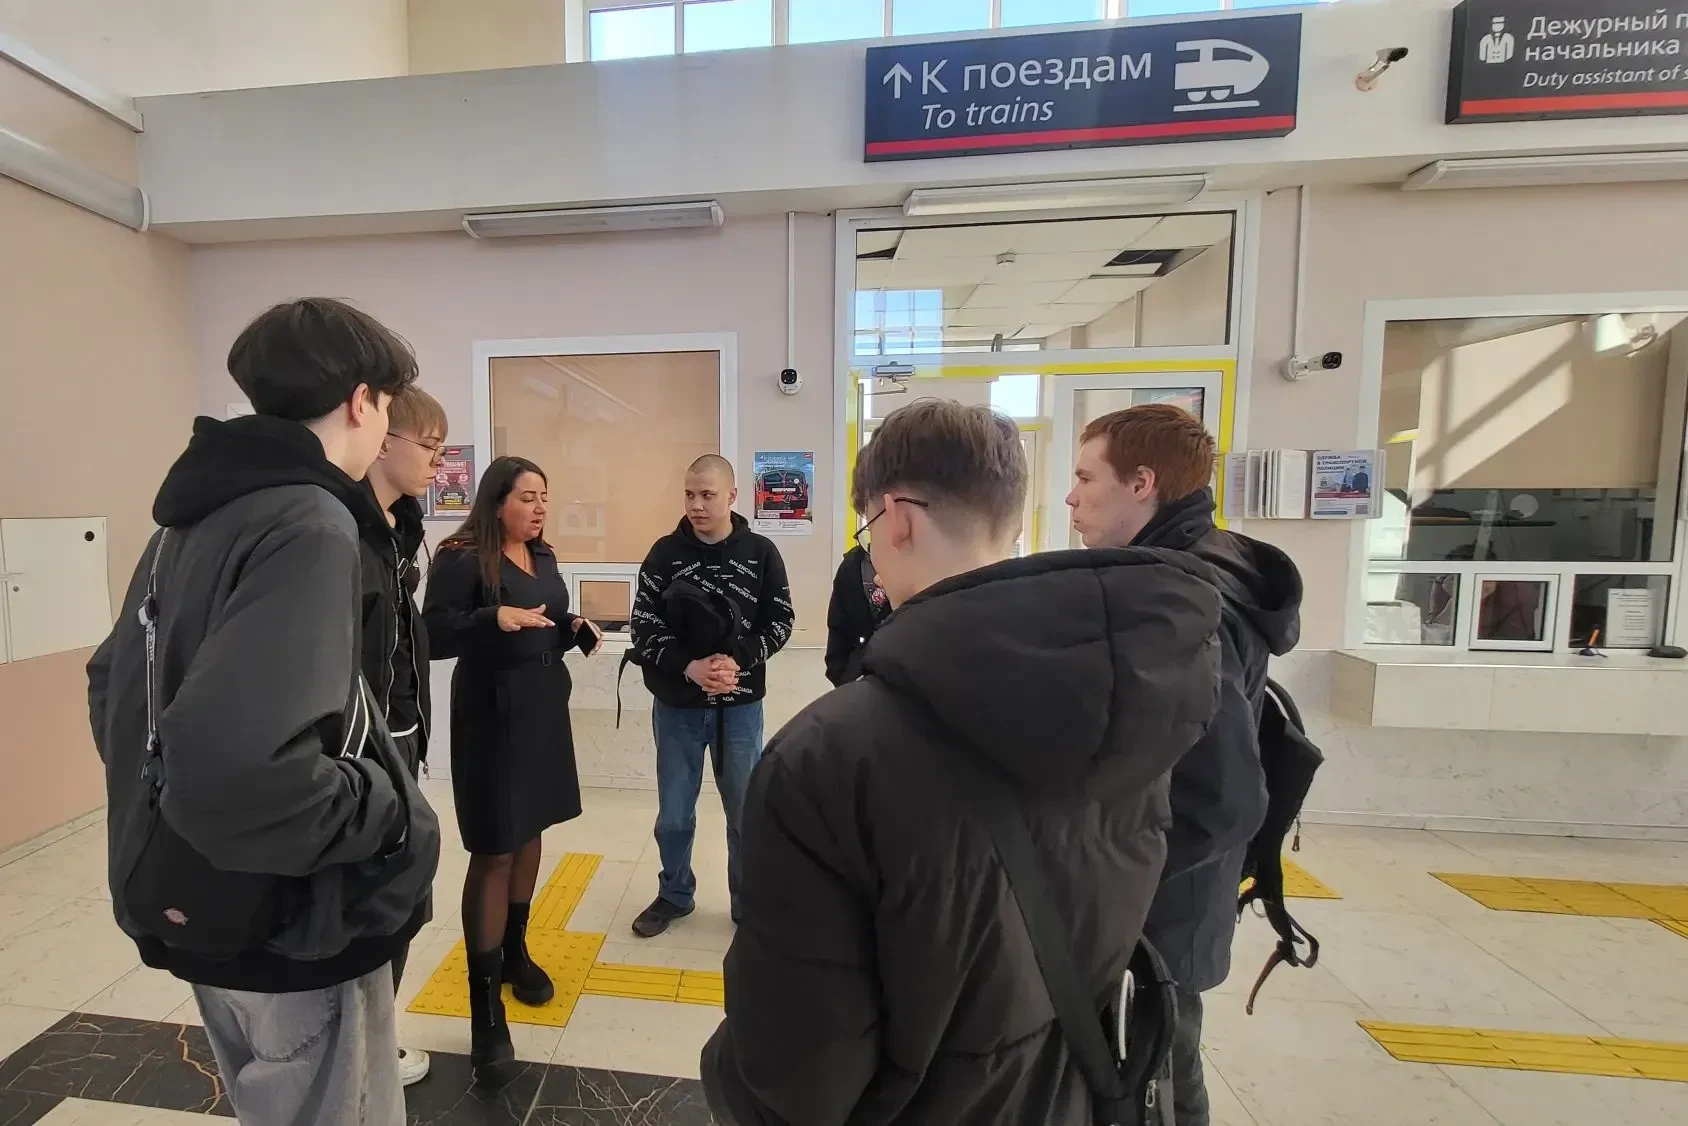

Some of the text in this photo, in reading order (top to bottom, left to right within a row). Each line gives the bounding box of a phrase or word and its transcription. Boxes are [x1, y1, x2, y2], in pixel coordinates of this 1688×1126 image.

[1527, 8, 1668, 41] Дежурный
[1525, 38, 1681, 62] начальника
[921, 52, 1153, 95] К поездам
[1523, 72, 1569, 90] Duty
[1572, 68, 1654, 86] assistant
[1659, 64, 1682, 81] of
[922, 96, 1055, 129] To trains
